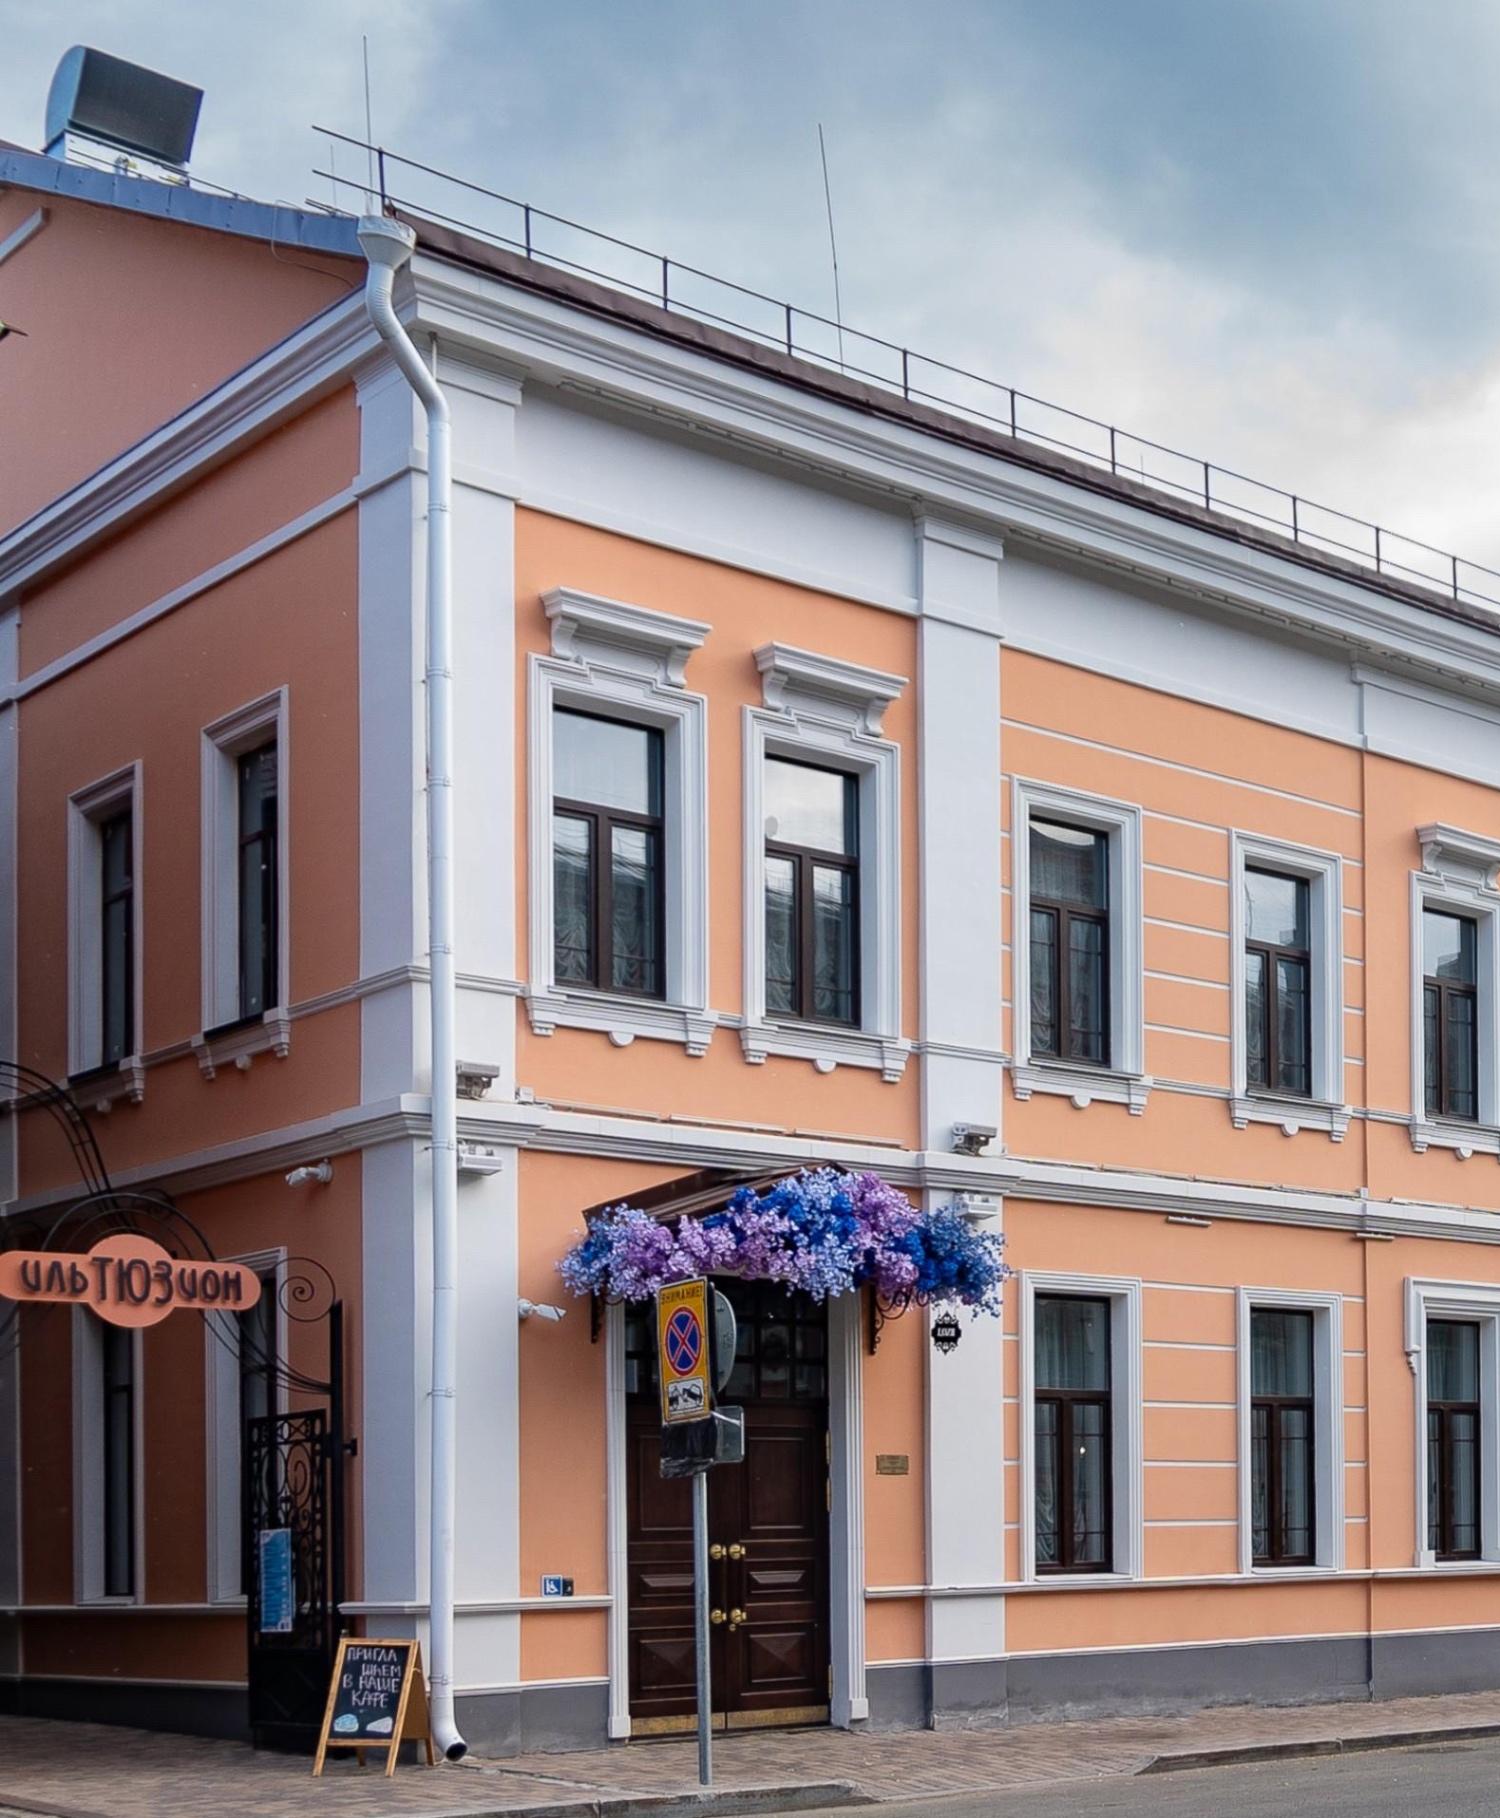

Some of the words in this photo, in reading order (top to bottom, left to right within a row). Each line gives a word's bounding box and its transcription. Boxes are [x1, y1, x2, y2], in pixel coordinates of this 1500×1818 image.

[342, 1673, 353, 1688] В
[359, 1676, 400, 1693] НАШЕ
[351, 1689, 389, 1708] КАФЕ
